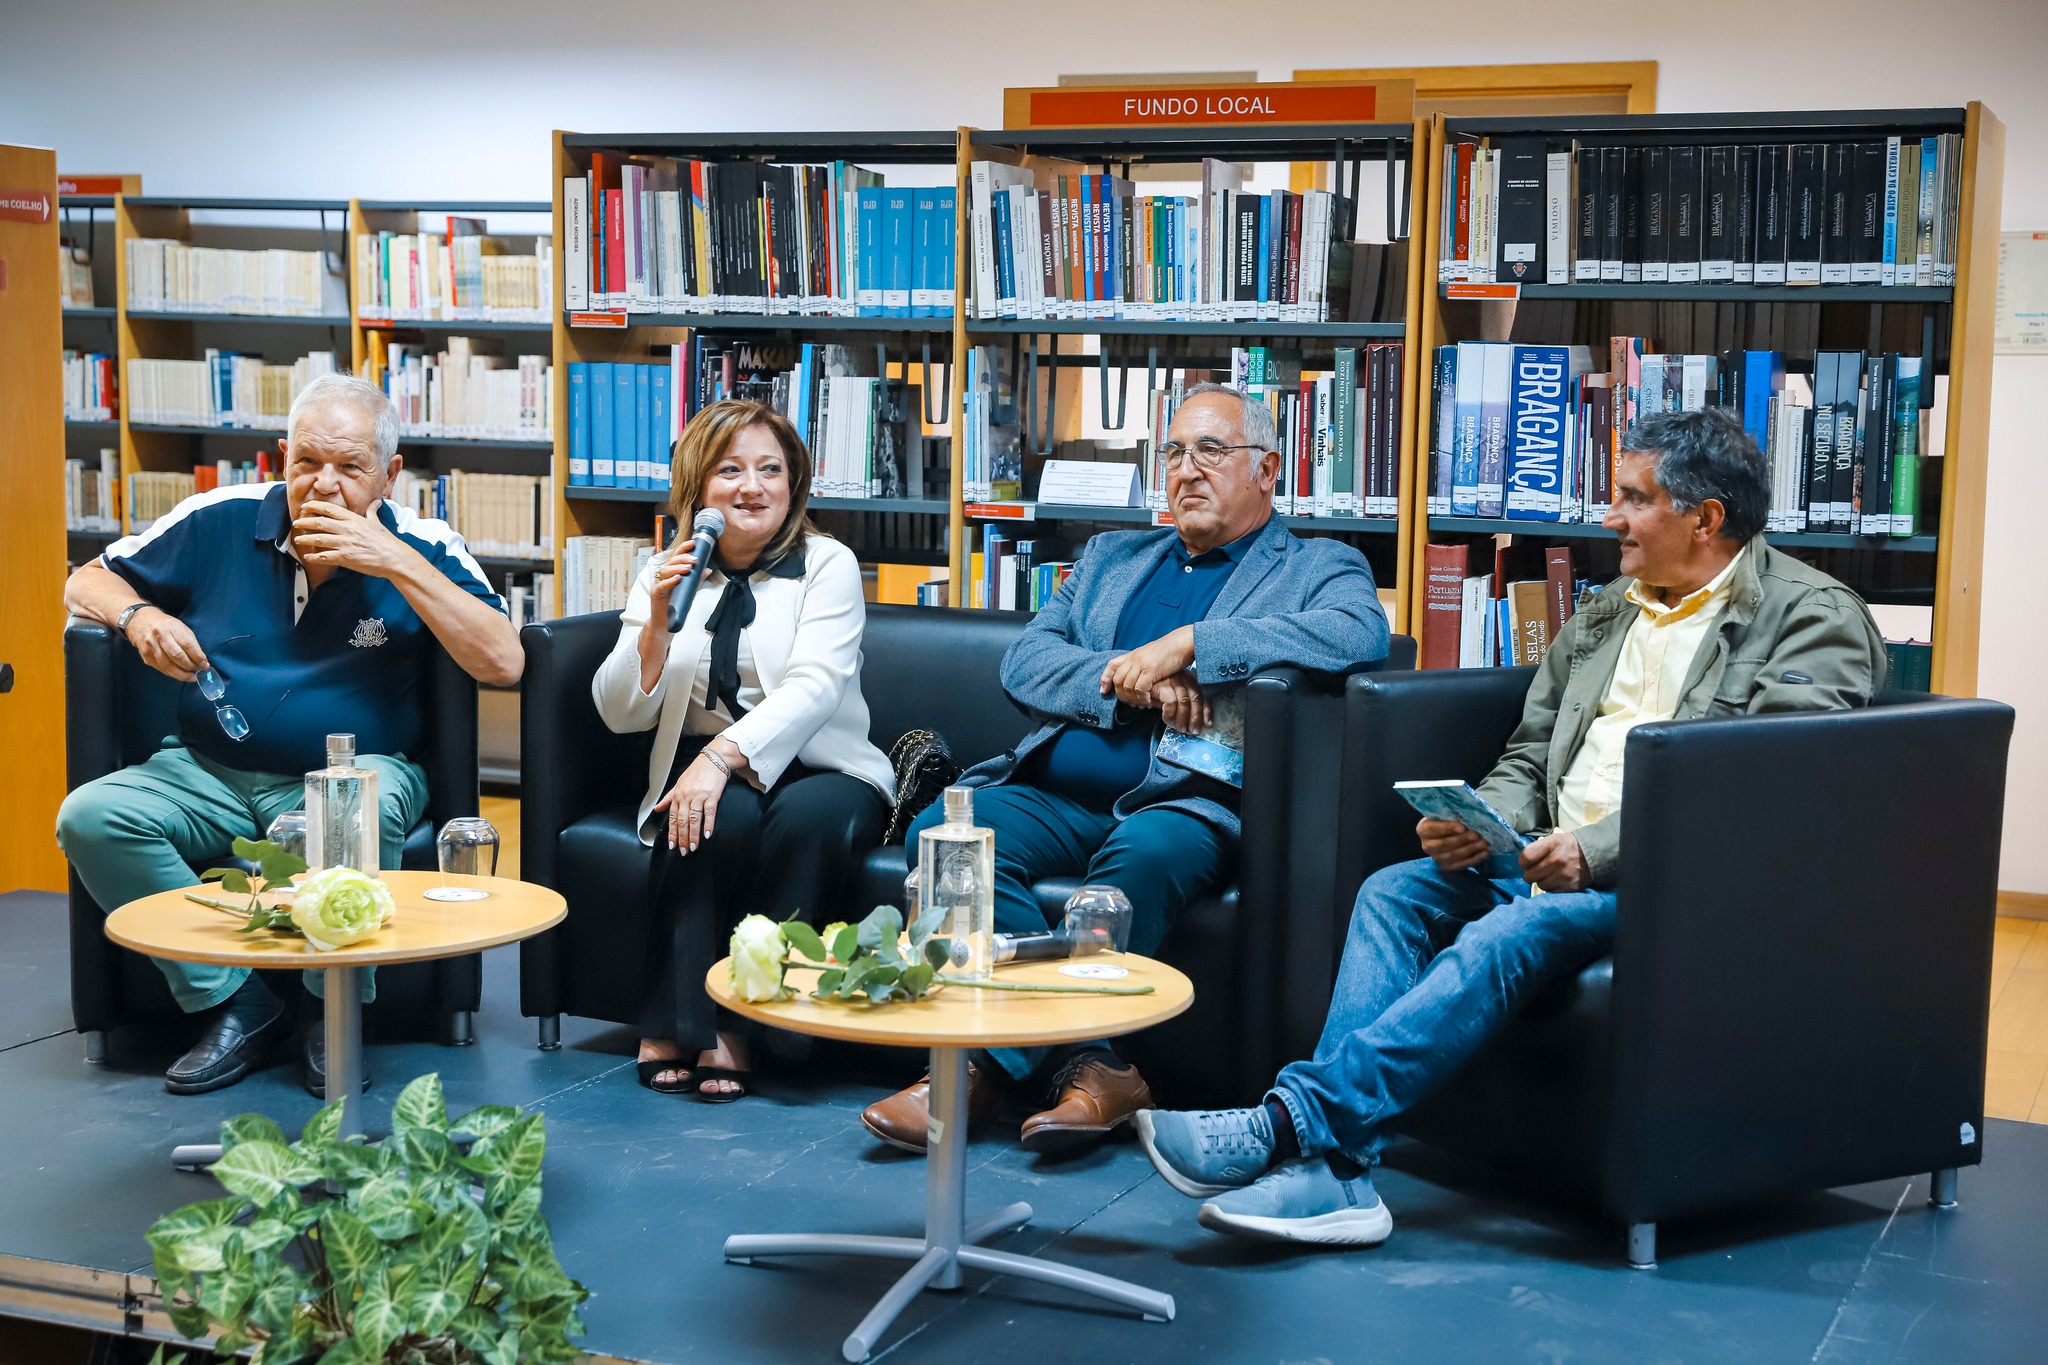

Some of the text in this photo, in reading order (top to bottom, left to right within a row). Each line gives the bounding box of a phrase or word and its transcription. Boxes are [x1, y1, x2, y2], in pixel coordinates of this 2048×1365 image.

[1124, 95, 1276, 116] FUNDO LOCAL
[1888, 142, 1898, 177] CATEDRAL
[57, 181, 77, 193] elho
[1886, 190, 1896, 210] BISPO
[1887, 179, 1896, 188] DA
[10, 200, 42, 211] COELHO
[1584, 194, 1593, 237] BRAGANÇA
[1607, 194, 1616, 237] BRAGANÇA
[1650, 193, 1660, 236] BRAGANÇA
[1712, 193, 1721, 236] BRAGANÇA
[1864, 193, 1874, 237] BRAGANÇA
[1902, 203, 1909, 211] DE
[1900, 213, 1909, 253] FREGUESIA
[1043, 233, 1052, 276] MEMÓRIAS
[1270, 261, 1278, 282] Danças
[1289, 261, 1297, 280] Mágico
[1302, 240, 1310, 272] Pauliteiros
[1248, 353, 1256, 382] BIOURB
[1256, 353, 1264, 382] BIOURB
[1444, 360, 1452, 395] BRAGANÇA
[1337, 400, 1345, 462] TRANSMONTANA
[1464, 416, 1475, 463] BRAGANÇA
[1490, 417, 1499, 464] BRAGANÇA
[1508, 362, 1562, 492] BRAGANÇ
[1813, 405, 1833, 483] NO SÉCULO XX
[1833, 417, 1854, 470] BRAGANÇA
[1317, 428, 1326, 467] Vinhais
[1428, 585, 1461, 595] Portugal
[1525, 620, 1539, 664] SELAS
[1540, 645, 1546, 654] do
